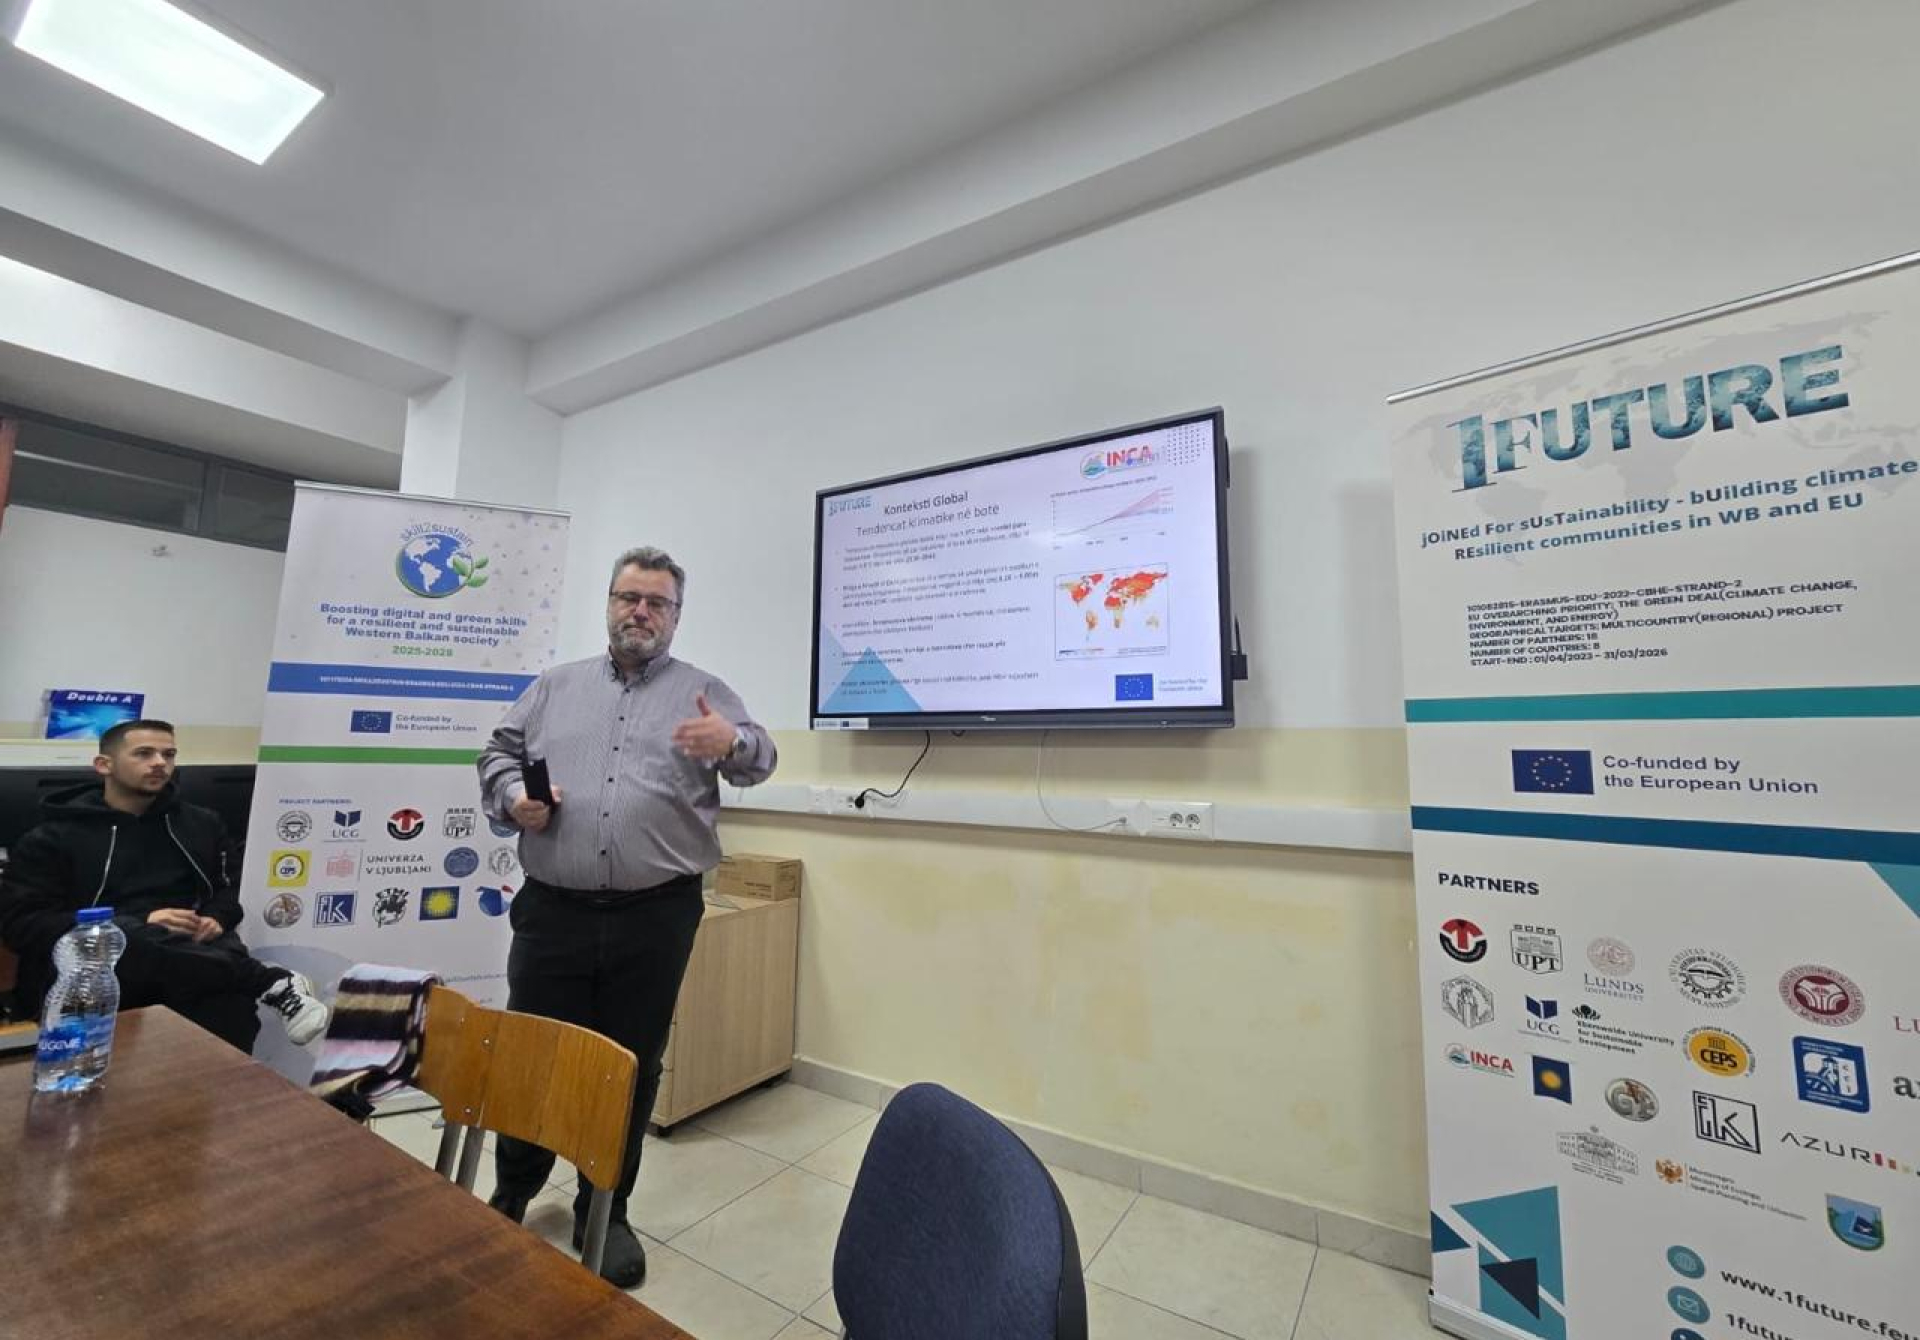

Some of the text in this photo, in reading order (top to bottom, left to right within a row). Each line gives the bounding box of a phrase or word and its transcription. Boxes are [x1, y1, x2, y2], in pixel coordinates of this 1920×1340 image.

[1446, 344, 1849, 493] 1FUTURE
[1107, 446, 1153, 467] INCA
[884, 491, 969, 516] Konteksti Global
[1485, 522, 1515, 536] For
[1520, 498, 1670, 531] sUsTainability
[1690, 478, 1798, 505] bUilding
[1805, 459, 1918, 488] climate
[1454, 492, 1864, 560] REsilient communities in WB and EU
[1468, 614, 1480, 622] EU
[1483, 606, 1557, 620] OVERARCHING
[1619, 599, 1639, 608] THE
[1643, 594, 1683, 607] GREEN
[1688, 585, 1785, 602] DEAL(CLIMATE
[1790, 580, 1858, 593] CHANGE,
[320, 603, 527, 627] Boosting digital and green skills
[327, 614, 519, 636] for a resilient and sustainable
[1470, 625, 1546, 640] GEOGRAPHICAL
[1601, 606, 1774, 630] MULTICOUNTRY(REGIONAL)
[1777, 603, 1844, 617] PROJECT
[1545, 615, 1569, 624] AND
[1570, 609, 1619, 622] ENERGY)
[345, 627, 499, 647] Western Balkan society
[1470, 638, 1510, 648] NUMBER
[1512, 637, 1524, 645] OF
[1470, 648, 1511, 658] NUMBER
[1513, 646, 1526, 655] OF
[1534, 652, 1593, 665] 01/04/2023
[67, 692, 133, 703] Double A
[395, 723, 408, 731] the
[411, 724, 450, 733] European
[396, 714, 452, 723] Co-funded by
[1603, 755, 1741, 774] Co-funded by
[1604, 774, 1818, 794] the European Union
[332, 829, 360, 838] UCG
[366, 854, 424, 863] UNIVERZA
[365, 865, 432, 875] V LJUBLJANI
[1438, 871, 1540, 896] PARTNERS
[1514, 952, 1561, 971] UPT
[1584, 973, 1645, 995] LUNDS
[1526, 1019, 1560, 1035] UCG
[1469, 1051, 1513, 1072] INCA
[1700, 1049, 1738, 1068] CEPS
[1726, 1313, 1795, 1340] 1futu
